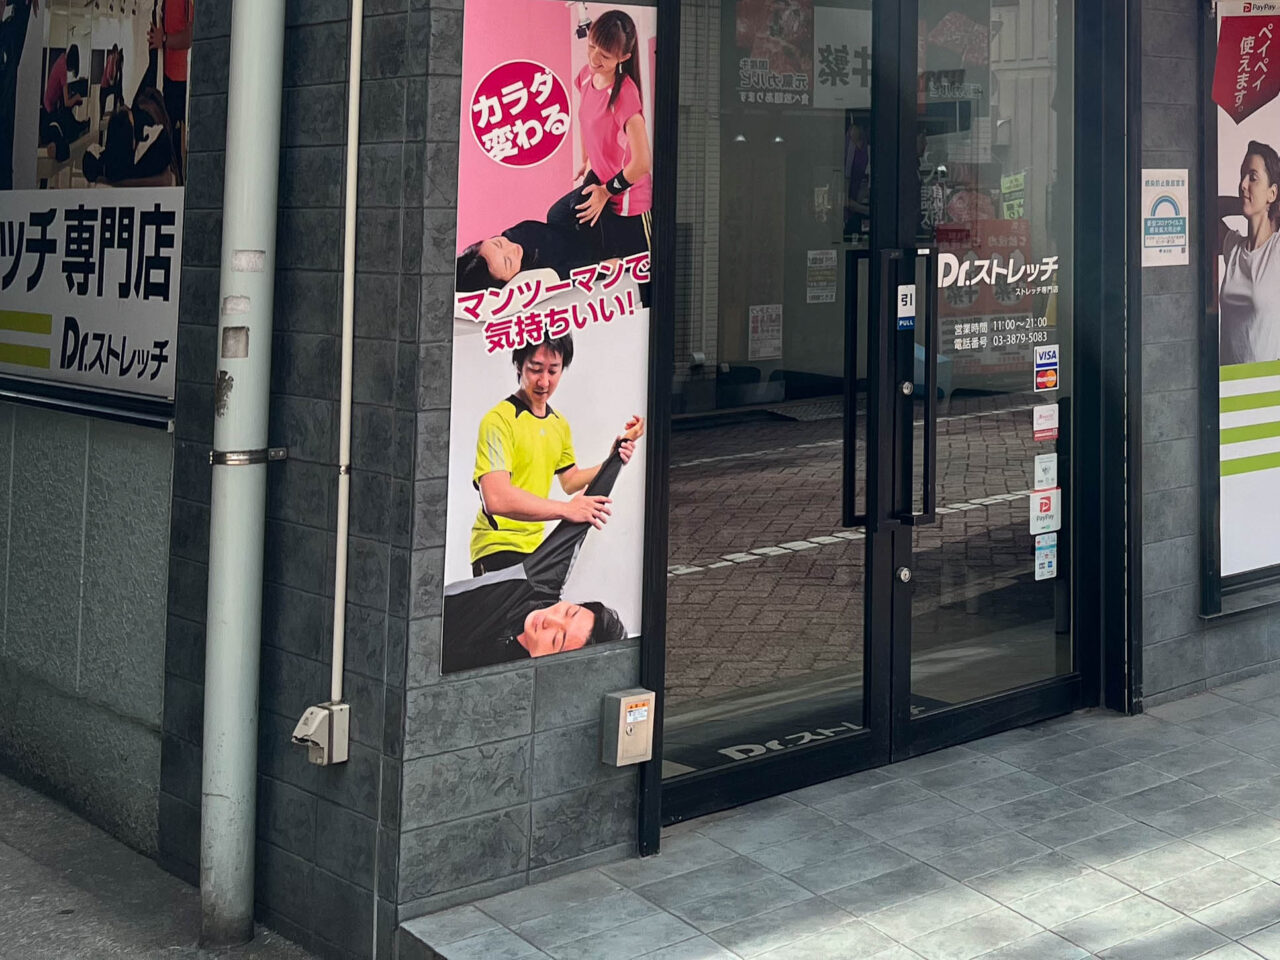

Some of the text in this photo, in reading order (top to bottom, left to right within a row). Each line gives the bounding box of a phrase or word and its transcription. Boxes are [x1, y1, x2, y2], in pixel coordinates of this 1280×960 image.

[1252, 2, 1277, 12] PayPay
[1252, 23, 1275, 91] ペイペイ
[472, 69, 554, 129] カラダ
[481, 104, 570, 162] 変わる
[937, 252, 1059, 288] Dr.ストレッチ
[457, 252, 651, 321] マンツーマンで
[1015, 285, 1059, 296] ストレッチ専門店
[900, 292, 914, 308] 引
[899, 319, 914, 327] PULL
[954, 321, 988, 336] 営業時間
[60, 315, 169, 381] Dr.ストレッチ
[953, 331, 1048, 351] 電話番号 03-3879-5083
[1038, 350, 1057, 361] VISA
[1036, 513, 1055, 523] PayPay
